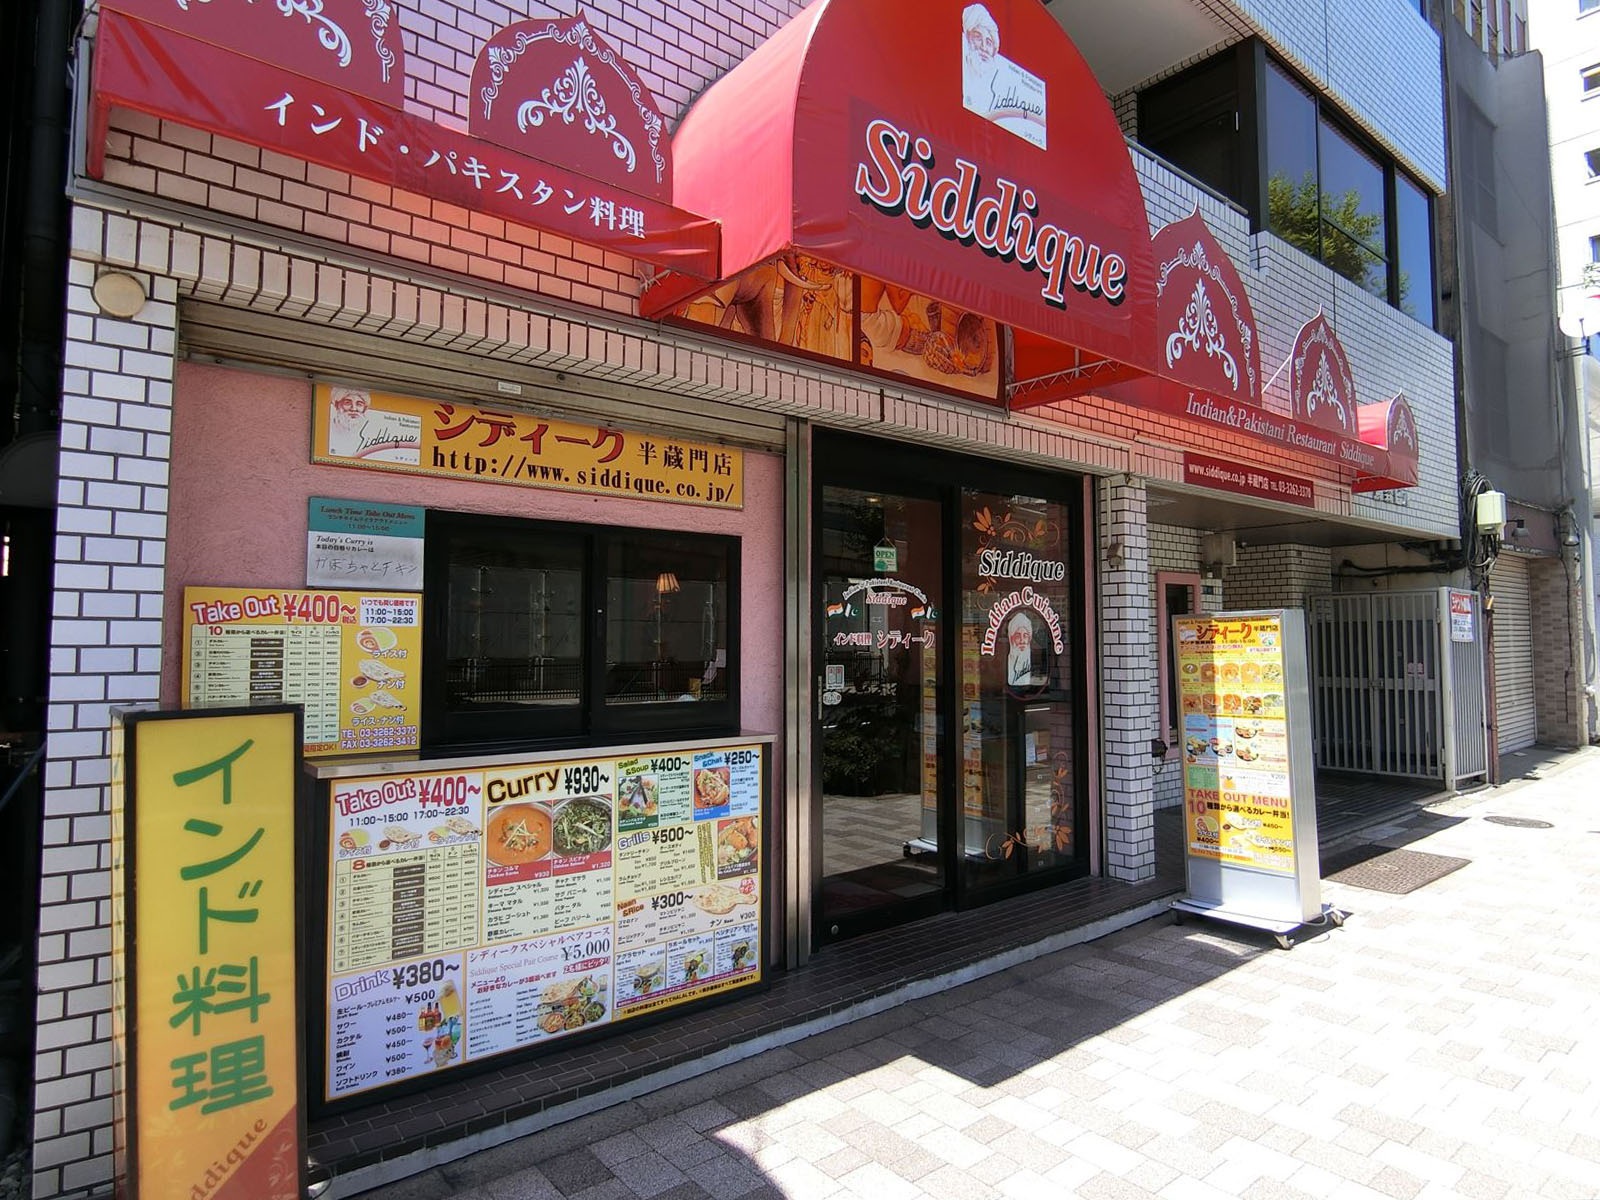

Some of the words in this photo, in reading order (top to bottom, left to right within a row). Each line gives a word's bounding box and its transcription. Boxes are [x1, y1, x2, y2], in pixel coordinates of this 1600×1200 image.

[989, 69, 1043, 119] Siddique
[263, 91, 646, 240] インド・パキスタン料理
[856, 119, 1127, 307] Siddique
[356, 420, 417, 449] Siddique
[433, 403, 625, 463] シディーク
[638, 441, 733, 477] 半蔵門店
[1287, 425, 1337, 456] Restaurant
[1340, 441, 1375, 467] Siddique
[433, 446, 735, 503] http://www.siddique.co.jp/
[1188, 464, 1246, 487] www.siddique.co.jp
[316, 536, 344, 544] Today's
[345, 537, 366, 546] Curry
[876, 550, 895, 558] OPEN
[979, 549, 1065, 583] Siddique
[191, 600, 242, 625] Take
[243, 593, 281, 617] Out
[866, 592, 907, 608] Siddique
[981, 591, 1022, 656] Indian
[1021, 586, 1064, 655] Cuisine
[834, 632, 872, 646] インド料理
[877, 630, 935, 649] シディーク
[1196, 623, 1252, 640] シディーク
[341, 730, 356, 738] TEL
[341, 741, 357, 749] FAX
[618, 759, 638, 769] Salad
[694, 752, 714, 762] Snack
[625, 765, 649, 776] &Soup
[487, 768, 560, 803] Curry
[335, 789, 381, 816] Take
[382, 778, 416, 804] Out
[1188, 789, 1219, 800] TAKE
[1223, 792, 1248, 803] OUT
[1252, 795, 1288, 808] MENU
[1189, 800, 1206, 814] 10
[618, 831, 651, 851] Grills
[617, 899, 637, 911] Naan
[622, 904, 645, 917] &Rice
[168, 738, 274, 1115] インド料理
[709, 920, 721, 928] ナン
[335, 970, 390, 1002] Drink
[405, 989, 435, 1004] ¥500
[336, 1062, 356, 1073] ワイン
